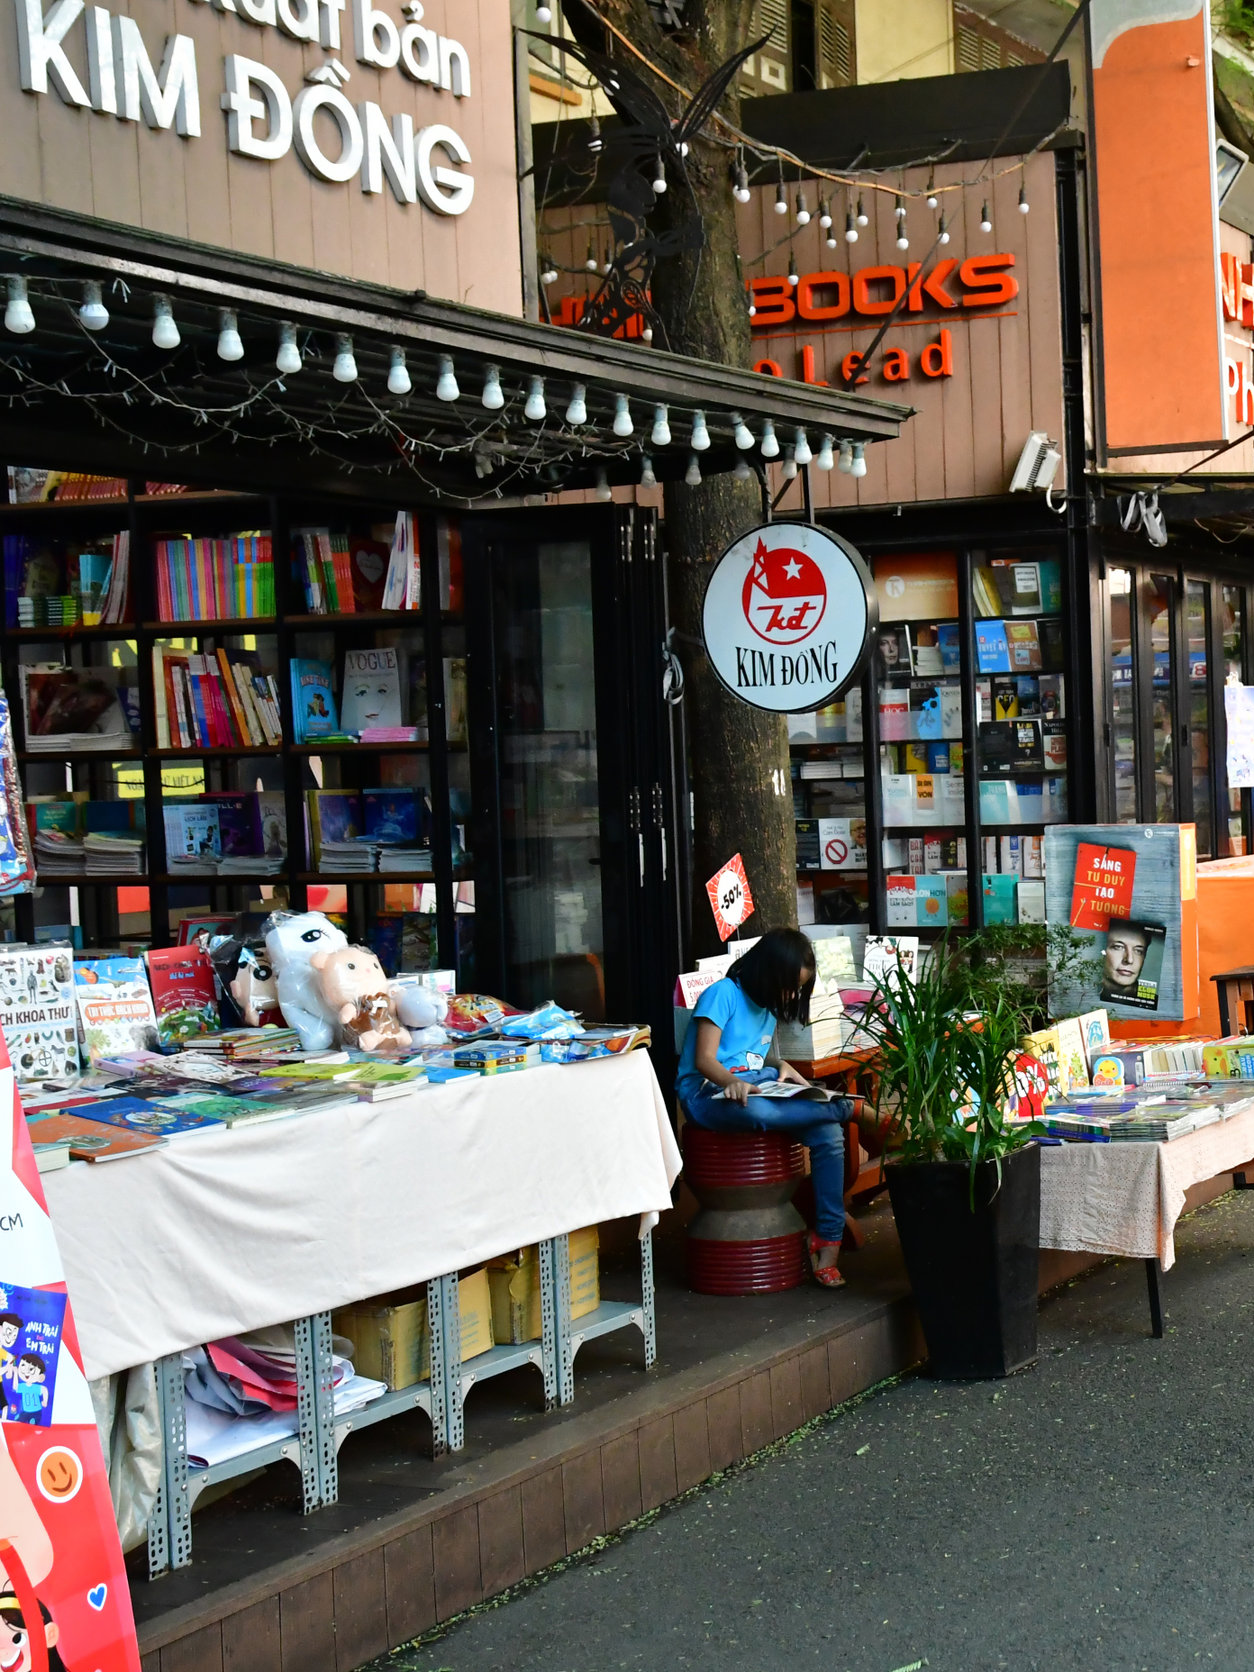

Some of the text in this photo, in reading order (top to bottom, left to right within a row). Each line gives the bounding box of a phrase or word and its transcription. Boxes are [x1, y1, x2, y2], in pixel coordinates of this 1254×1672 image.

[15, 0, 475, 216] KIM ĐỒNG
[802, 328, 955, 388] Lead
[348, 651, 396, 671] VOGUE
[735, 640, 838, 688] KIM ĐỒNG
[1104, 873, 1125, 887] DUY
[0, 1013, 14, 1026] CH
[16, 1009, 46, 1023] KHOA
[1015, 1063, 1046, 1098] 0%
